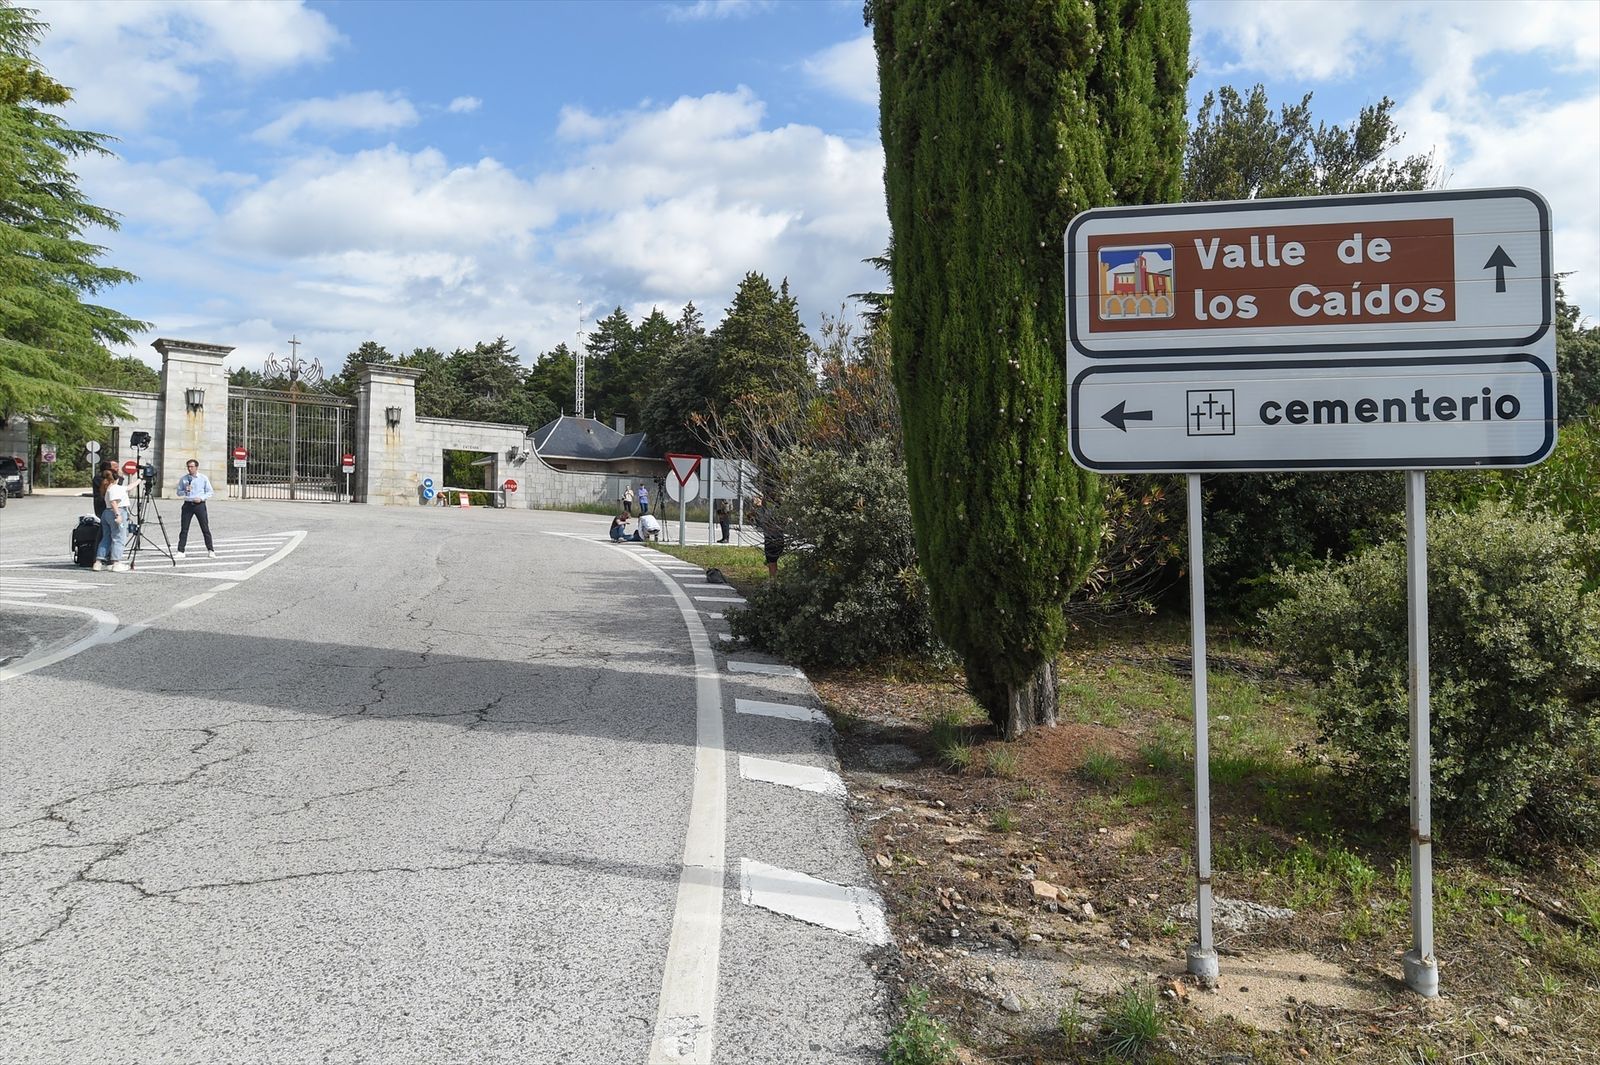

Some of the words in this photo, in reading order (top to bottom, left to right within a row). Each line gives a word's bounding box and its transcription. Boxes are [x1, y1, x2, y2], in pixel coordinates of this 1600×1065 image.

[1194, 235, 1306, 270] Valle
[1337, 232, 1392, 265] de
[1194, 288, 1258, 321] los
[1289, 281, 1446, 317] Caídos
[1259, 386, 1521, 426] cementerio
